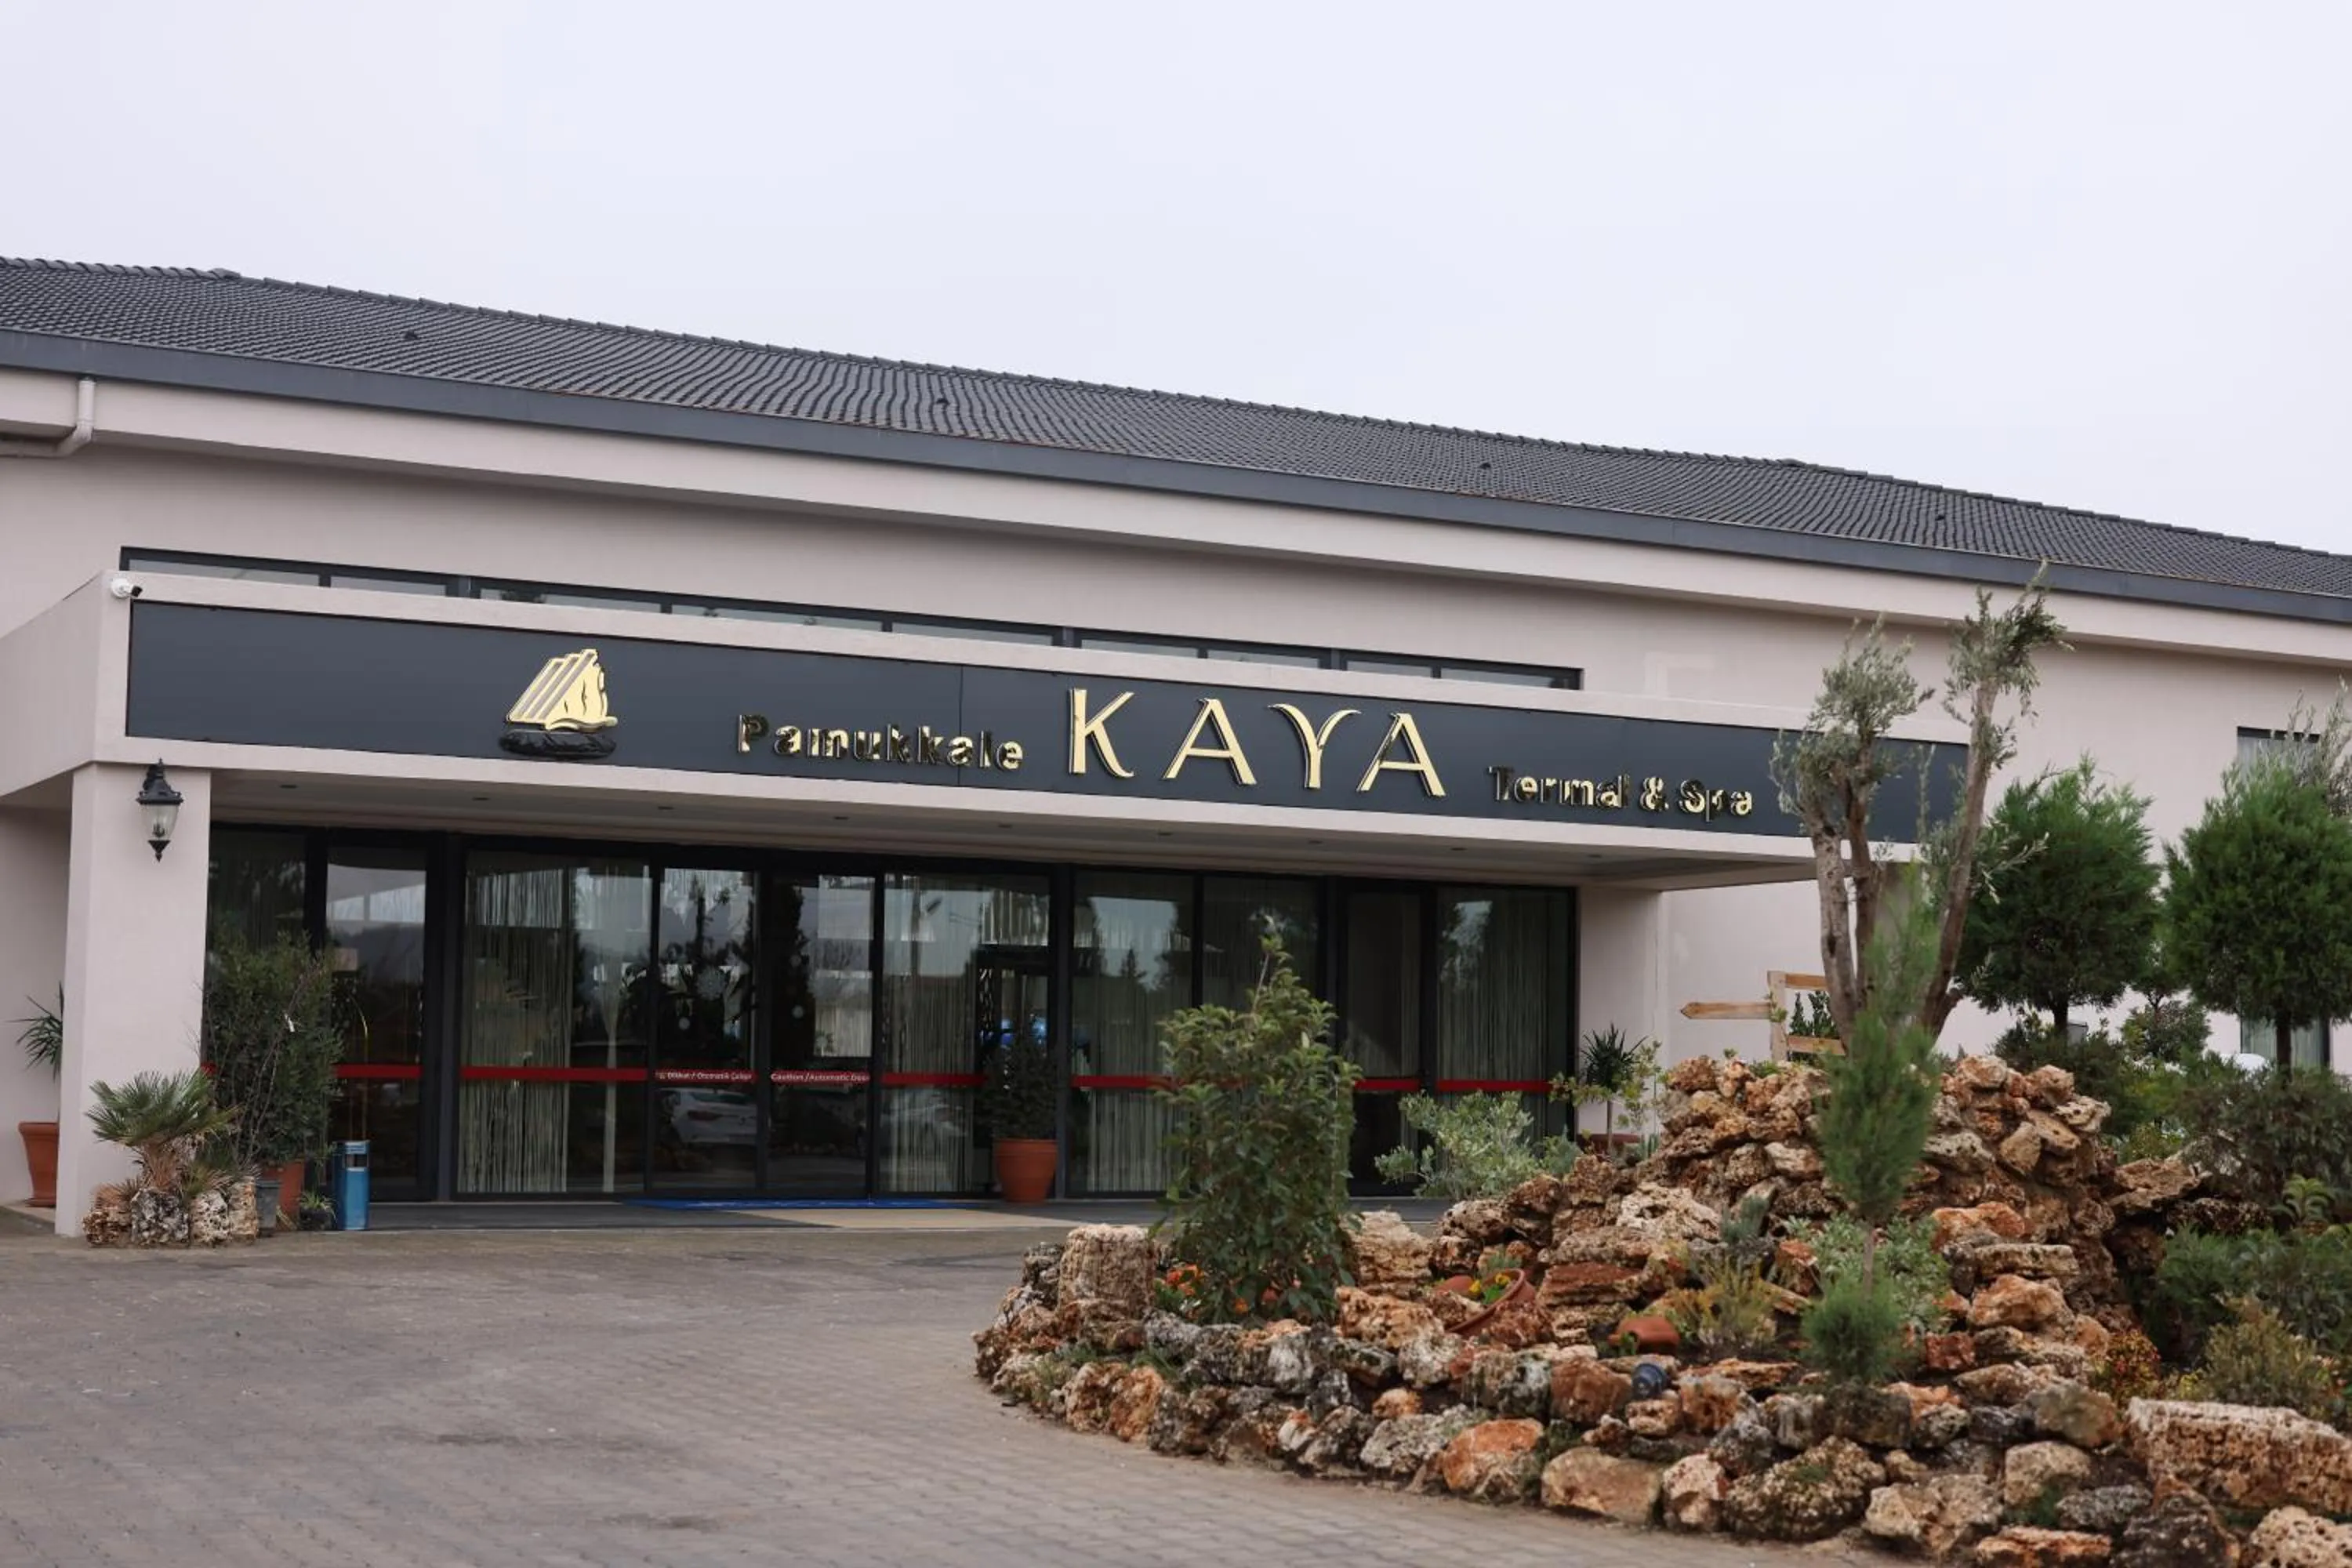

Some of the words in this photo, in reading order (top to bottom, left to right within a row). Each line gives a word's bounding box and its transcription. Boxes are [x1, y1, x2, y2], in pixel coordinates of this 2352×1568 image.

[736, 713, 1024, 773] Pamukkale
[1068, 688, 1446, 797] KAYA
[1487, 765, 1630, 808] Termal
[1639, 776, 1669, 811] &
[1678, 779, 1753, 822] Spa
